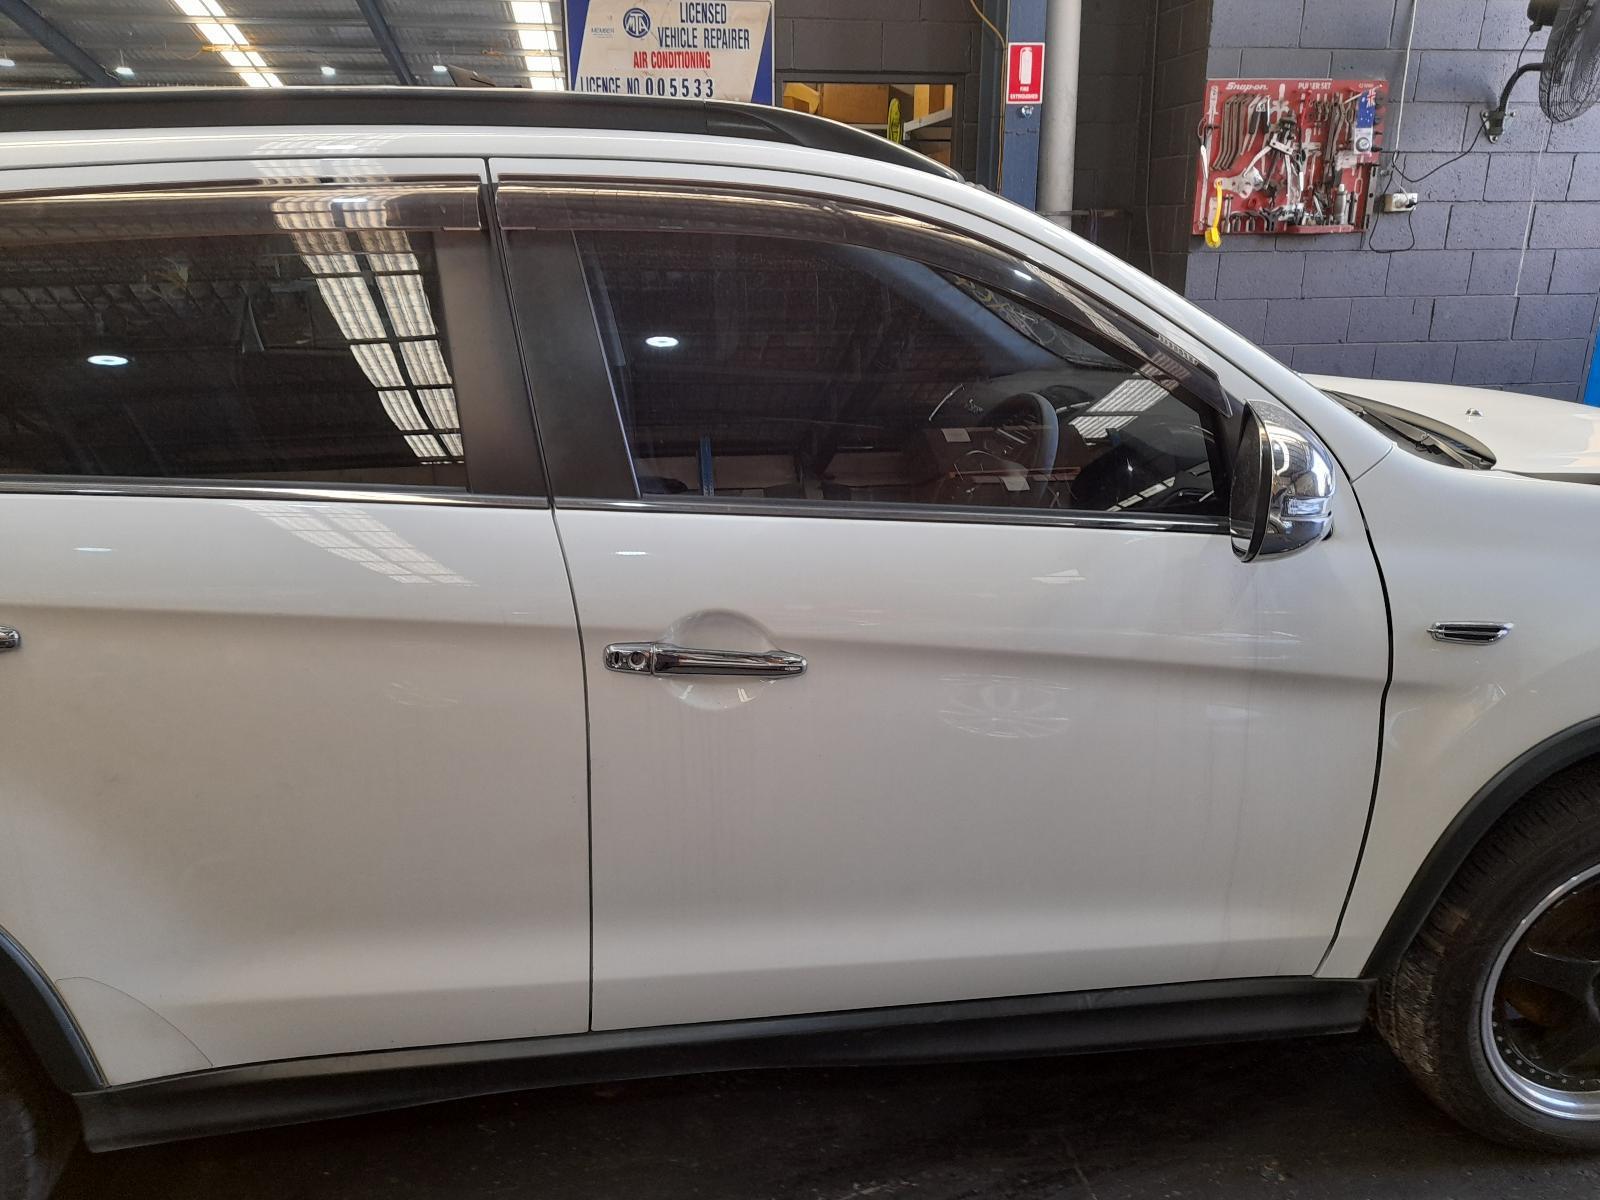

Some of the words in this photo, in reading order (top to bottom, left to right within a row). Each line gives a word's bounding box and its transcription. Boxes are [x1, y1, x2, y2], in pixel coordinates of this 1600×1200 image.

[679, 2, 727, 24] LICENSED
[657, 27, 698, 48] VEHICLE
[703, 28, 750, 50] REPAIRER
[633, 51, 649, 69] AIR
[651, 51, 711, 69] CONDITIONING
[580, 76, 621, 93] LICENCE
